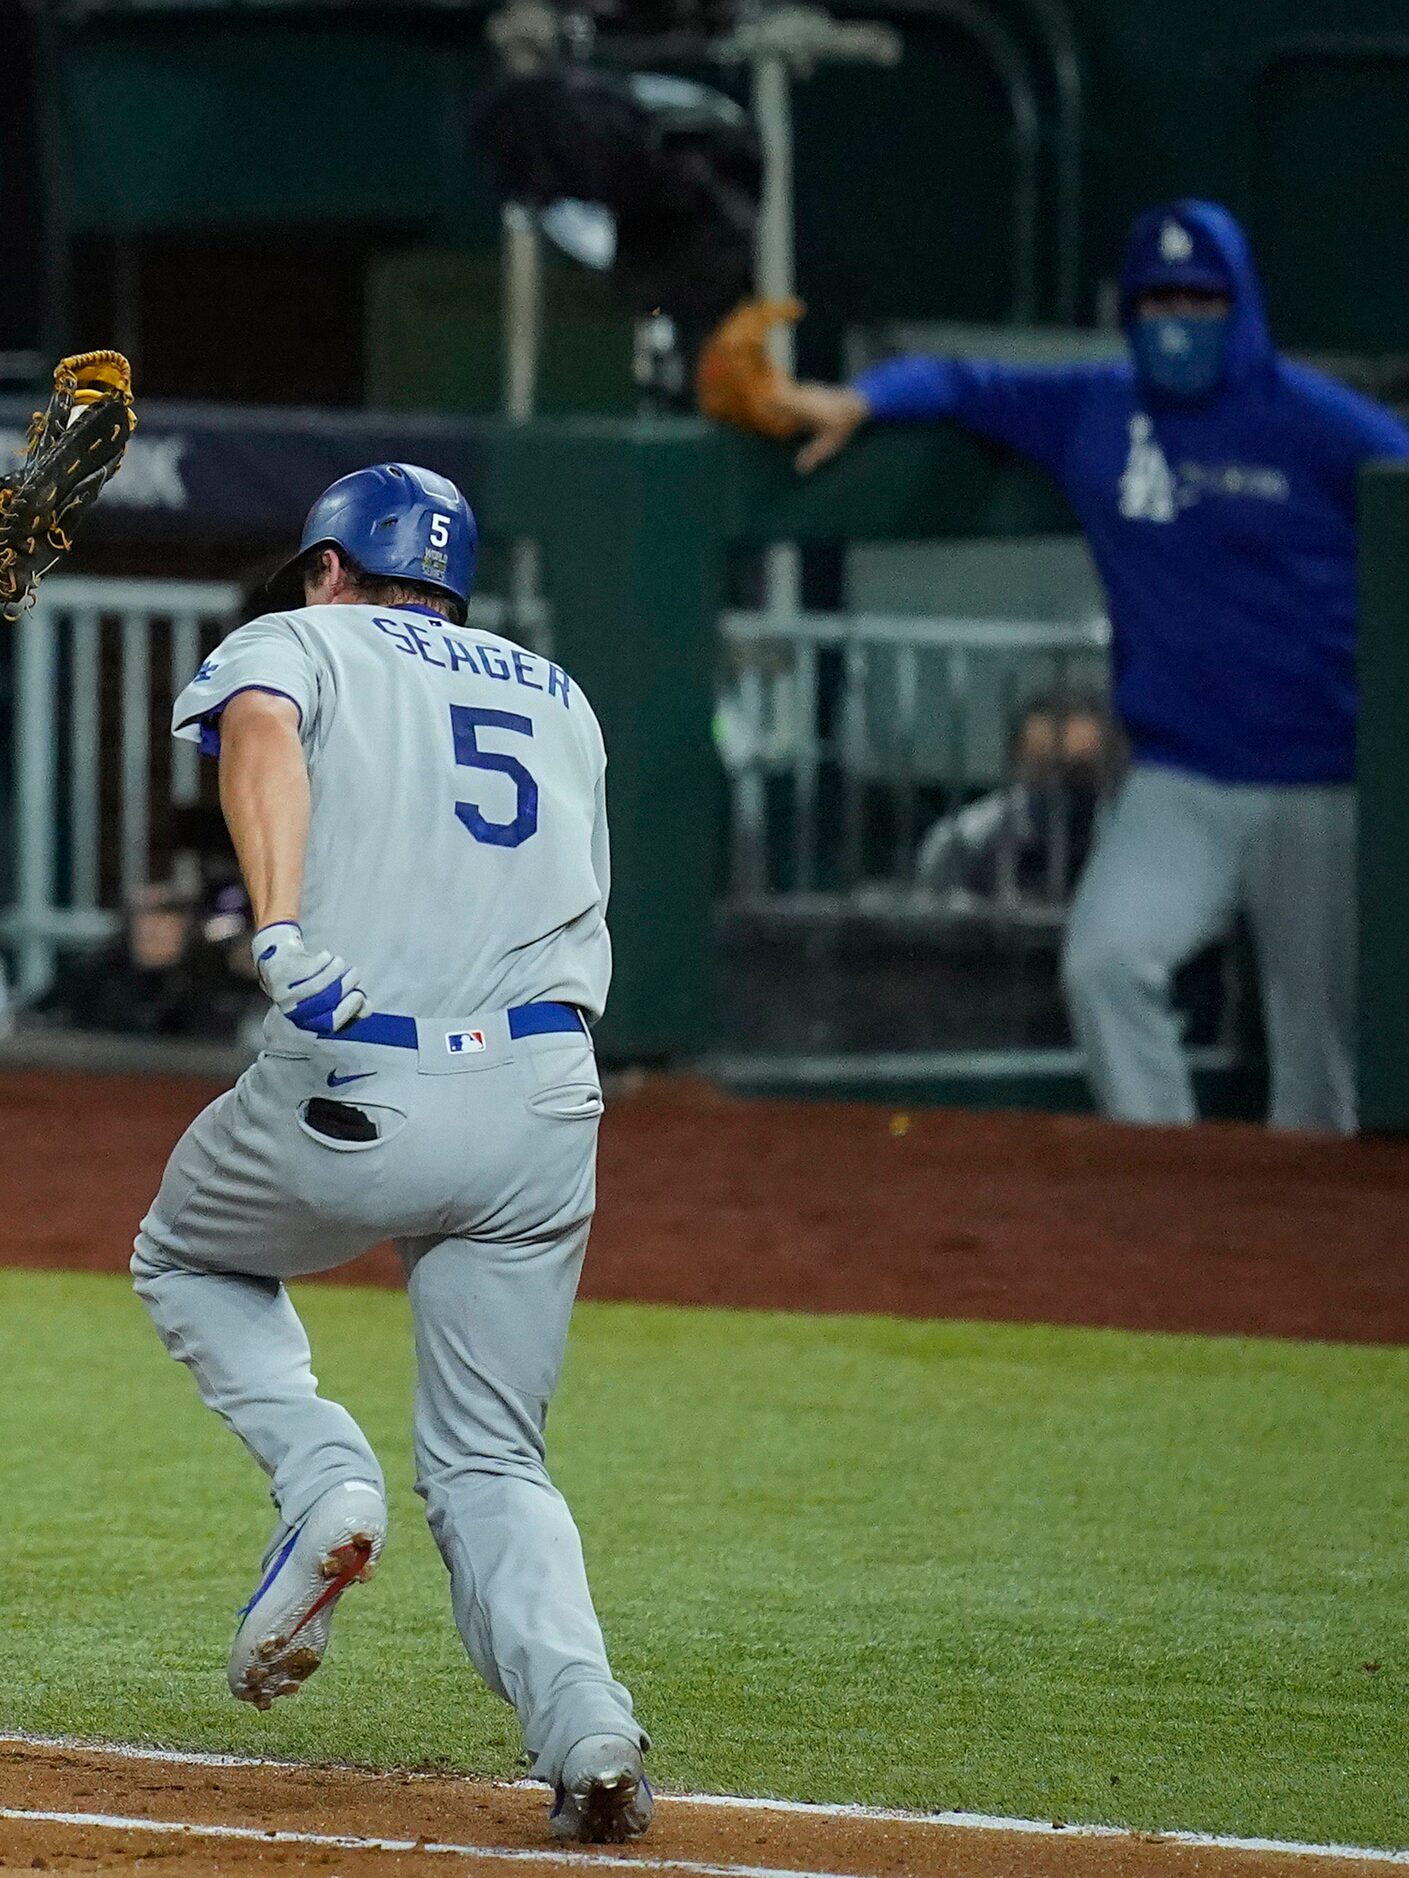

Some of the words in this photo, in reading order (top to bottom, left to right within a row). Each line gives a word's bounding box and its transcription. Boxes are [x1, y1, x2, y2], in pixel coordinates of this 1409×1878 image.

[429, 512, 451, 548] 5
[372, 616, 571, 710] SEAGER
[449, 703, 539, 848] 5
